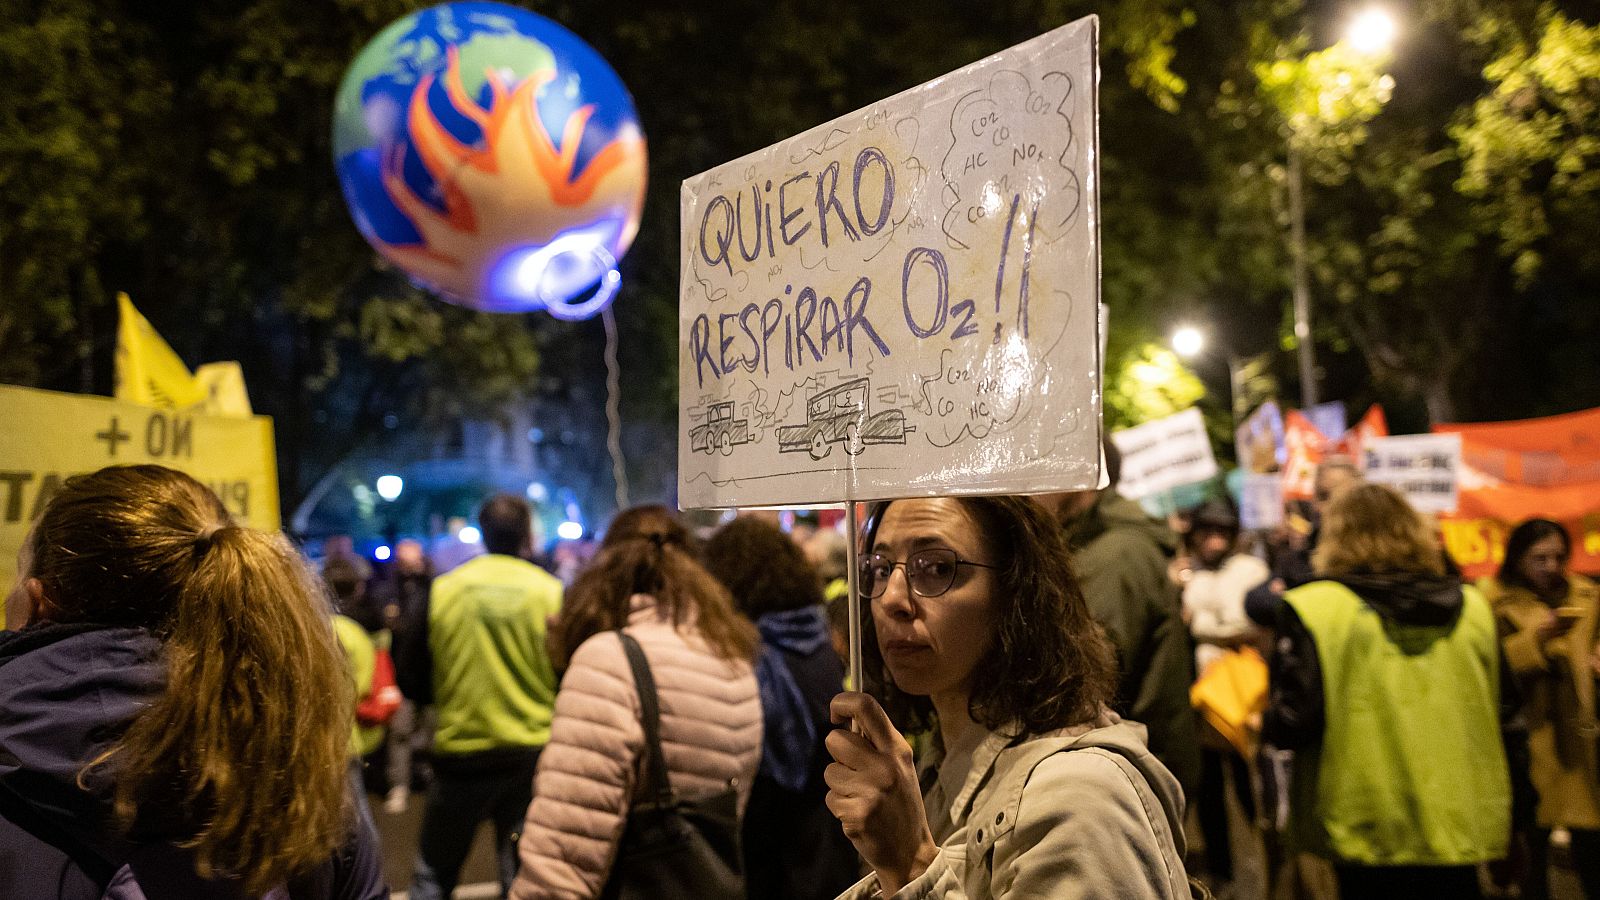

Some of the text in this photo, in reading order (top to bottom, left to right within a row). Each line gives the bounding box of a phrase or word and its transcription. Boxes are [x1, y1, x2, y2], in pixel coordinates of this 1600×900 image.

[971, 111, 999, 137] CO2
[992, 126, 1010, 147] CO
[963, 152, 989, 176] HC
[937, 396, 954, 417] CO
[970, 401, 990, 420] HC
